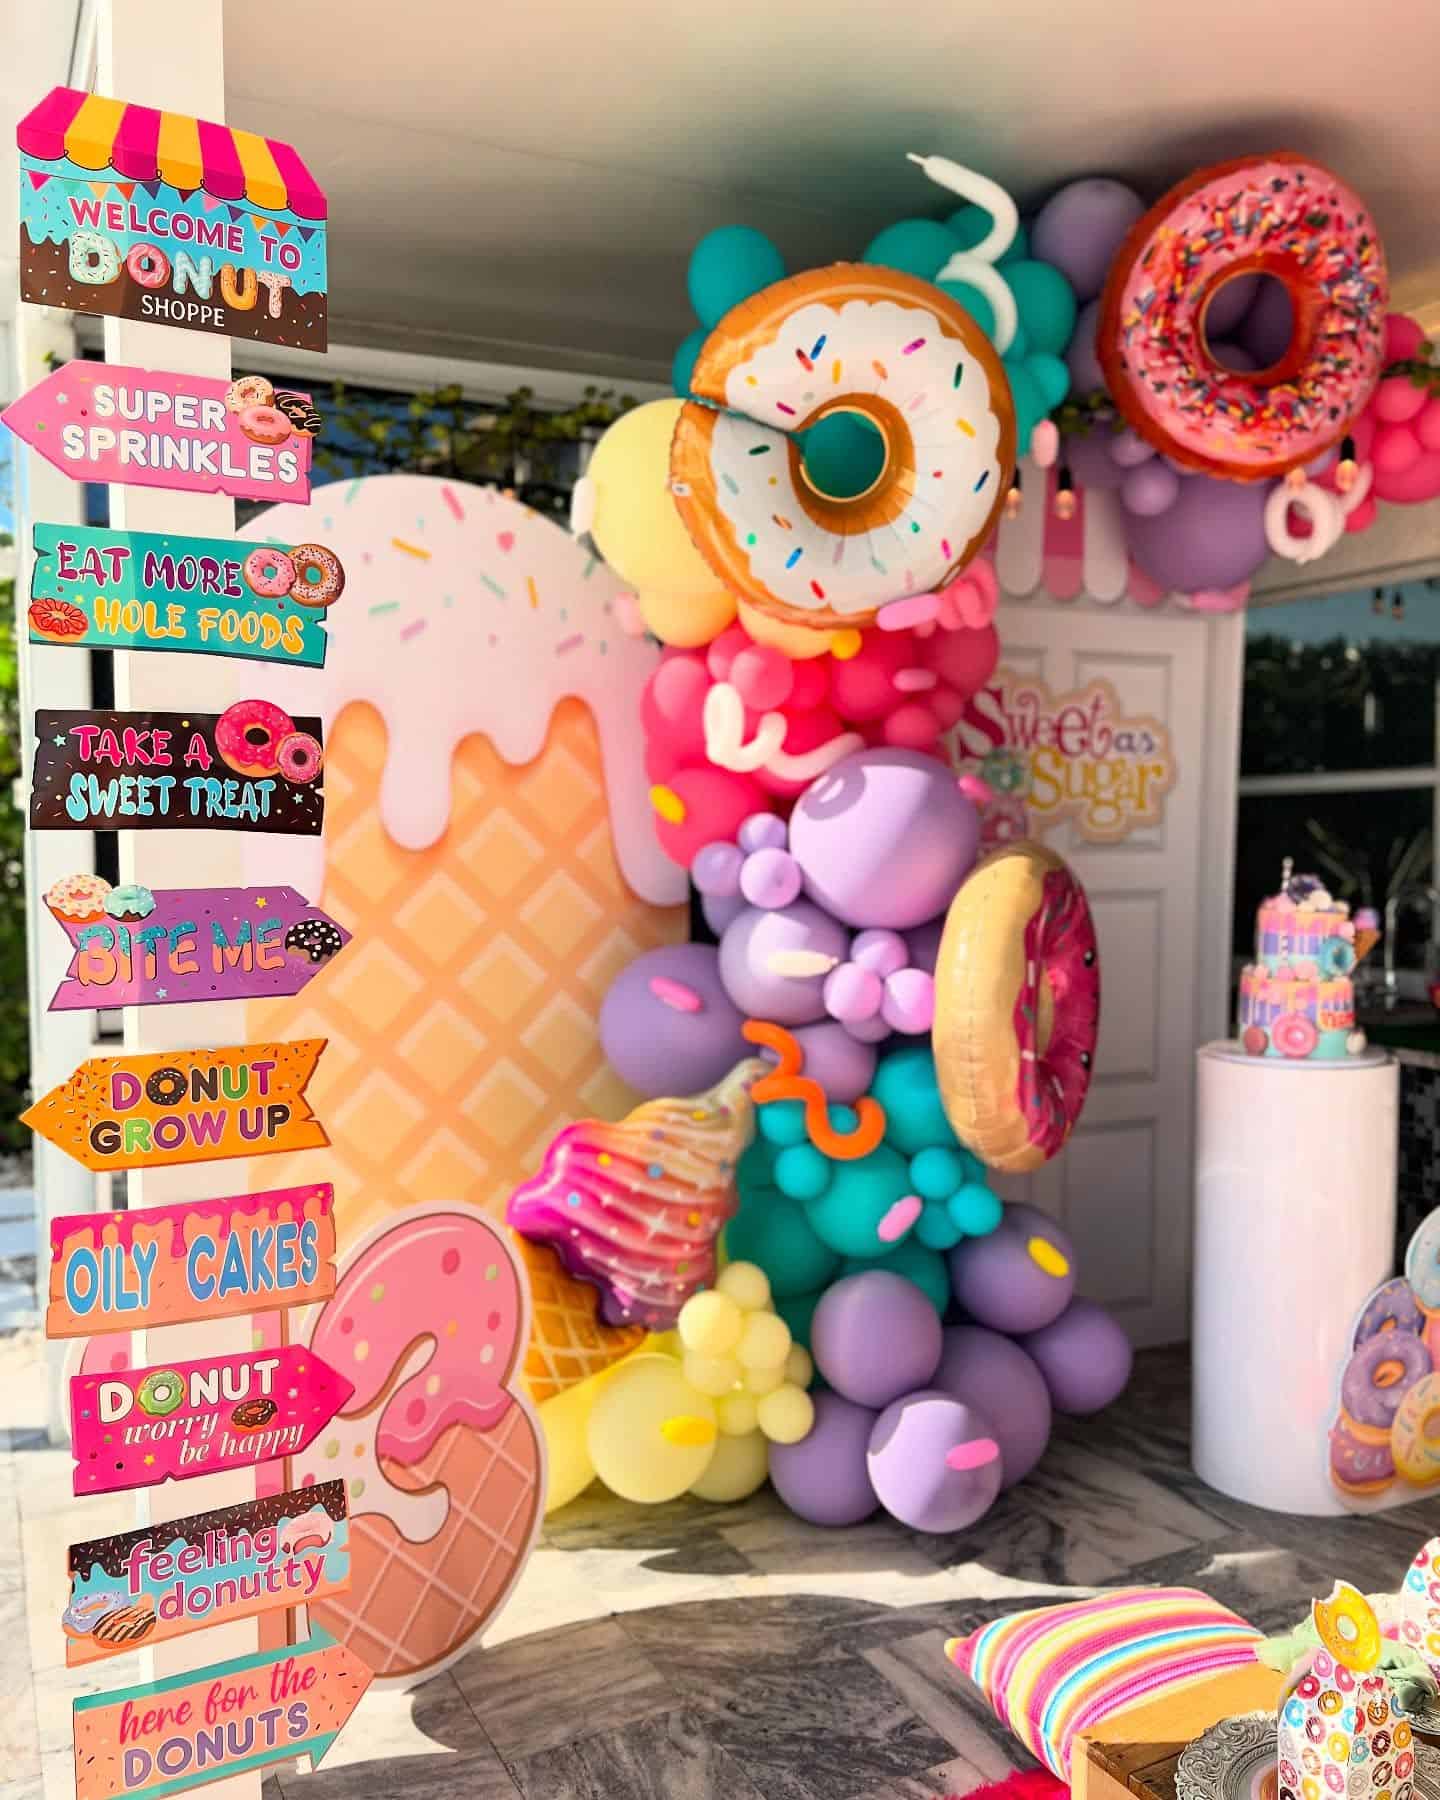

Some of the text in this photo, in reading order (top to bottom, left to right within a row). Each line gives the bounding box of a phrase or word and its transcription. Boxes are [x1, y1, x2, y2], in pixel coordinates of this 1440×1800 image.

[69, 196, 302, 270] WELCOME TO
[69, 230, 292, 318] DONUT
[141, 295, 225, 327] SHOPPE
[93, 384, 227, 432] SUPER
[61, 424, 298, 484] SPRINKLES
[57, 542, 243, 597] EAT MORE
[94, 596, 304, 654] HOLE FOODS
[69, 724, 212, 770] TAKE A
[65, 773, 276, 821] SWEET TREAT
[1029, 746, 1164, 829] Sugar
[77, 918, 285, 986] BITE ME
[110, 1061, 276, 1111] DONUT
[90, 1104, 290, 1155] GROW UP
[65, 1220, 318, 1315] OILY CAKES
[99, 1358, 279, 1424] DONUT
[123, 1412, 219, 1445] worry
[180, 1424, 304, 1464] be happy
[121, 1526, 280, 1596] feeling
[158, 1553, 327, 1621] donutty
[120, 1657, 318, 1745] here for the
[123, 1701, 311, 1788] DONUTS
